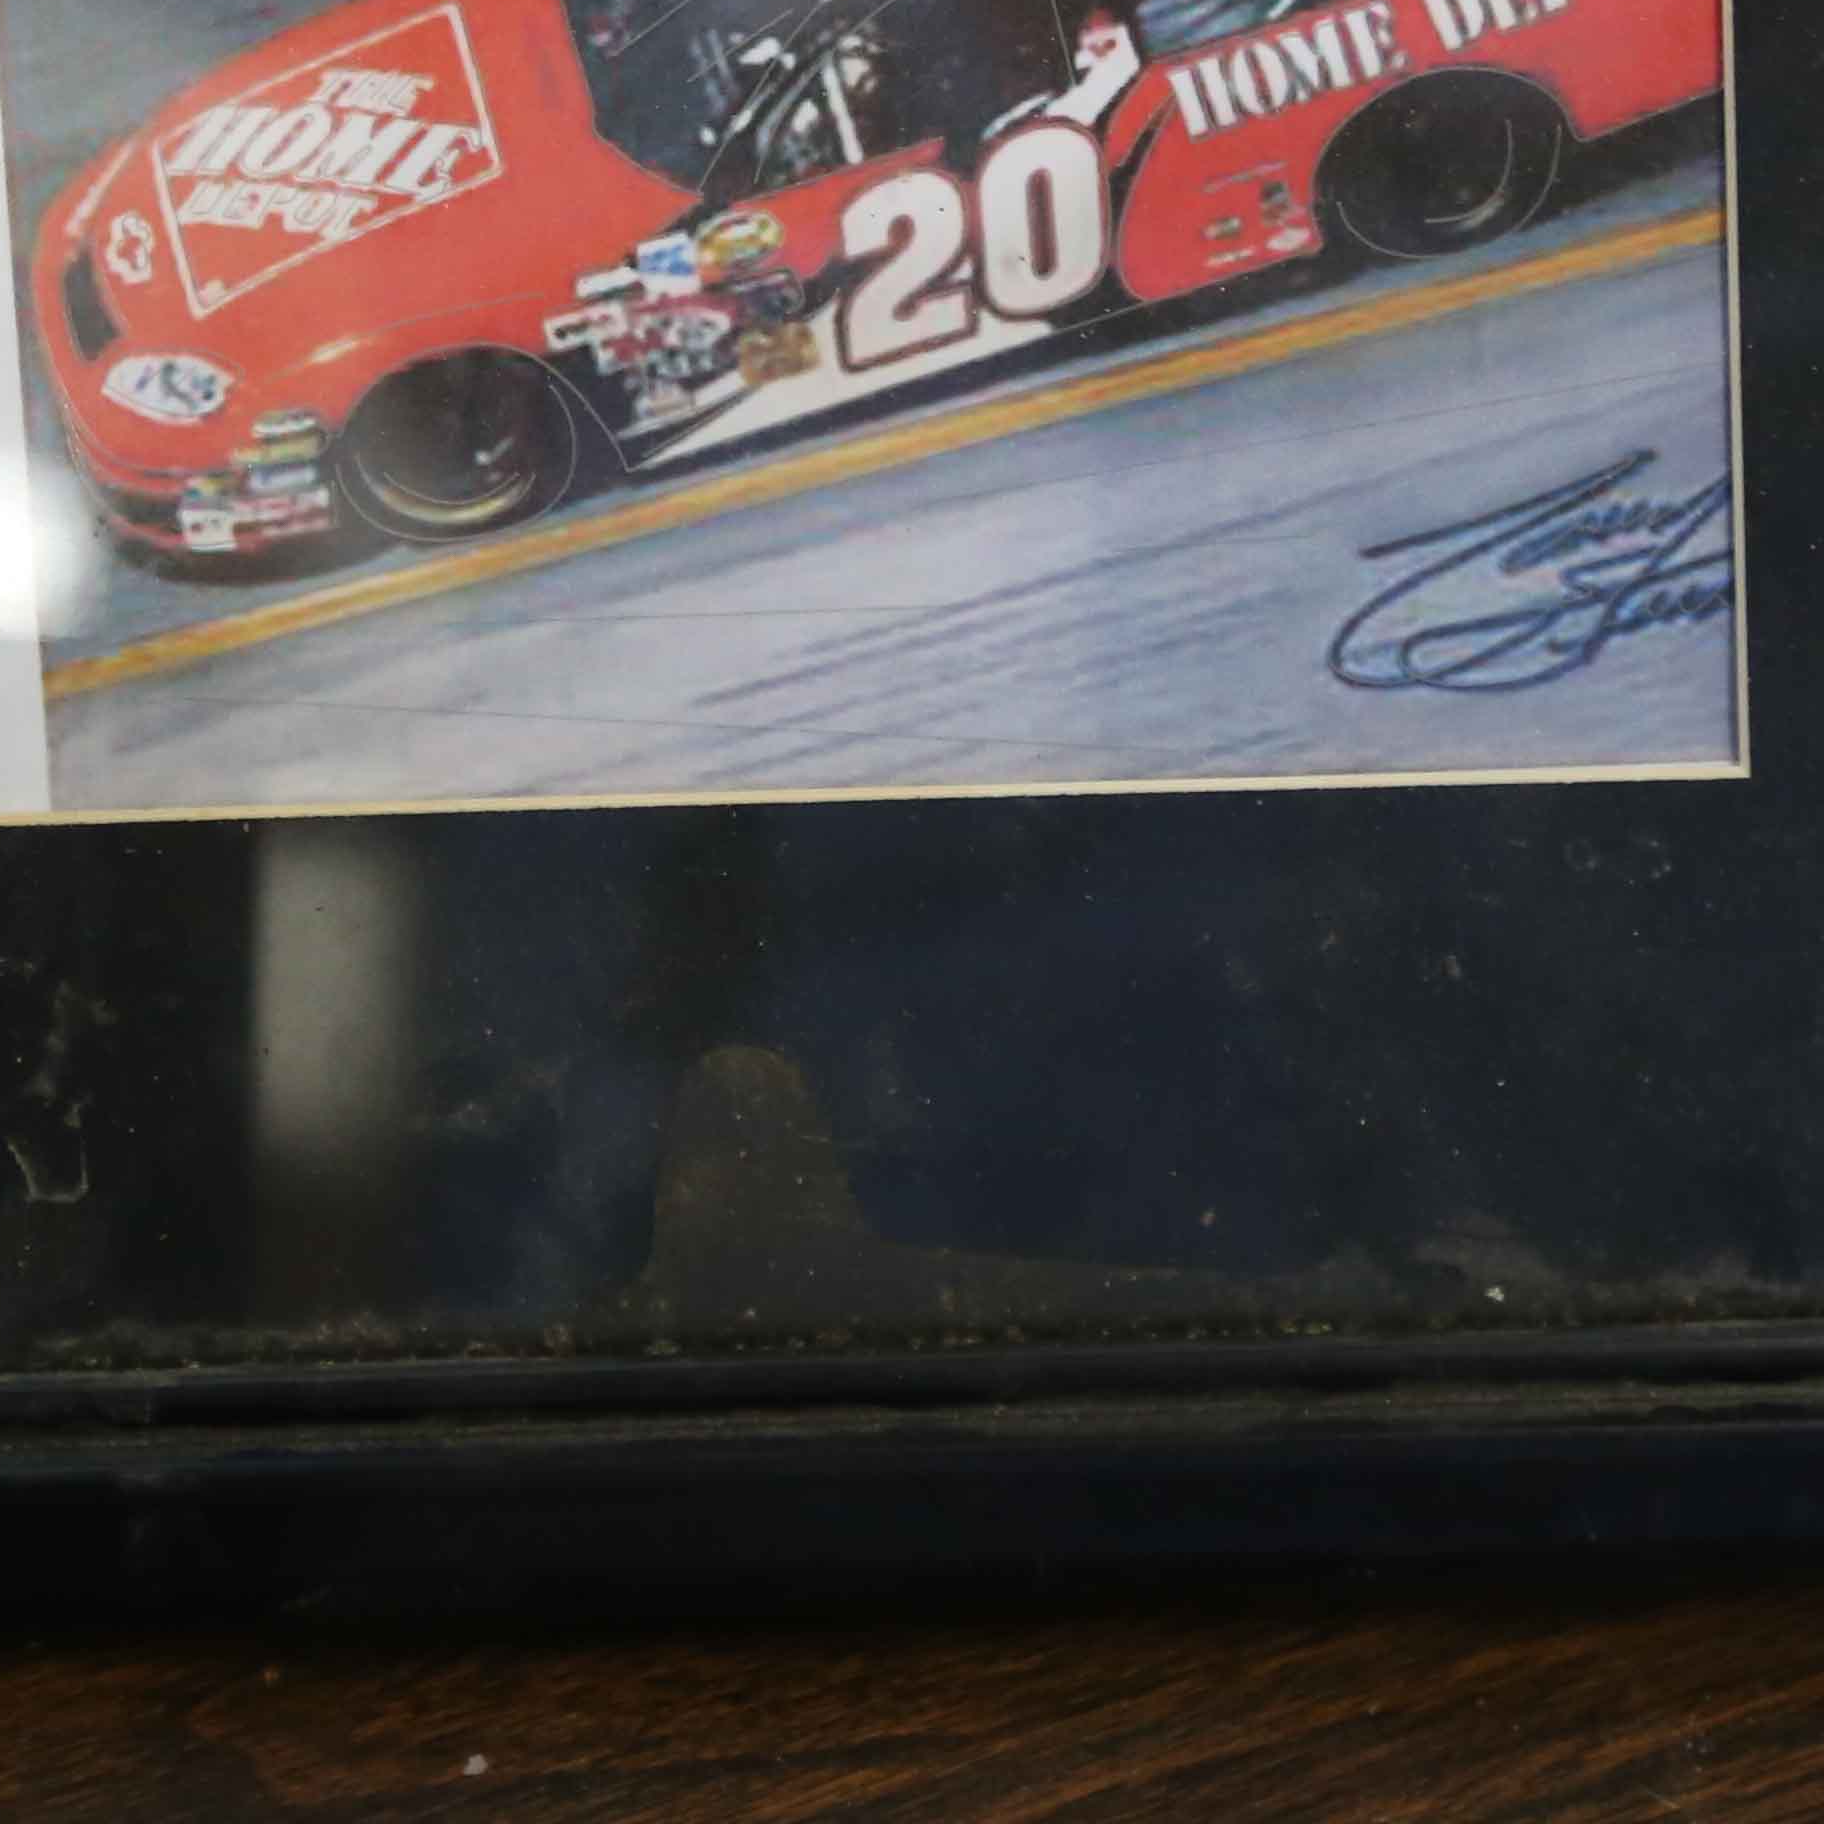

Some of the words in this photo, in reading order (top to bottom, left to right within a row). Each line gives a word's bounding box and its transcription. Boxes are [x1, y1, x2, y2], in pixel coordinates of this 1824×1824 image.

[308, 65, 434, 117] THE
[1167, 0, 1410, 142] HOME
[164, 102, 484, 202] HOME
[176, 179, 379, 240] DEPOT
[840, 123, 1107, 375] 20
